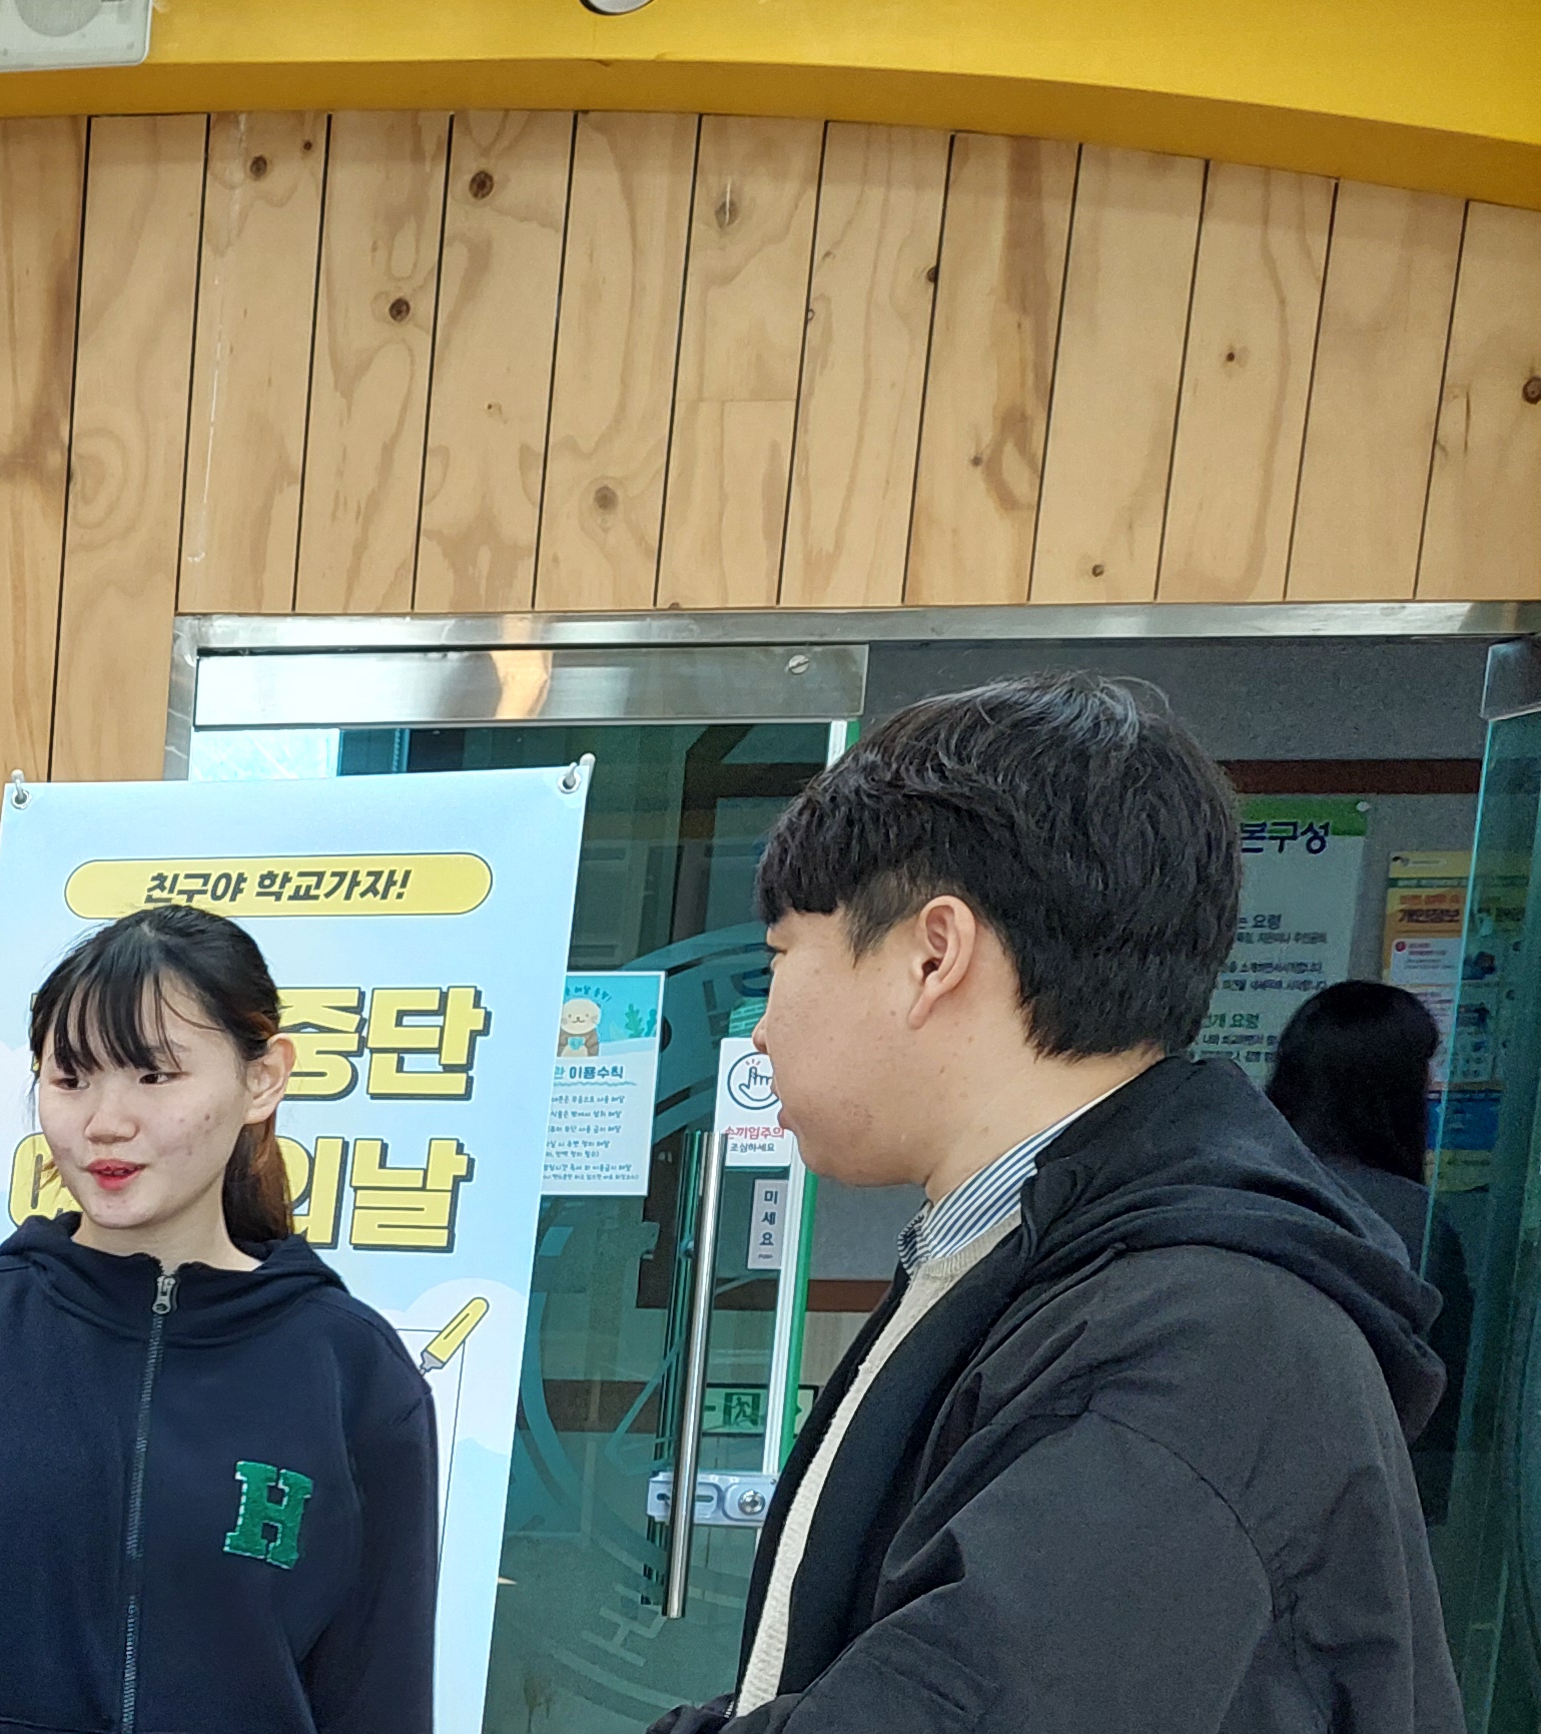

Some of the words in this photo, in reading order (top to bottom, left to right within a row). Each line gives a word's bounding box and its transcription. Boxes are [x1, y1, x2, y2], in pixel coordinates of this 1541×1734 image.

[144, 872, 245, 904] 친구야
[254, 869, 412, 902] 학교가자!
[280, 986, 491, 1101] 중단
[569, 1065, 624, 1080] 이용수칙
[759, 1190, 778, 1246] 미세요
[222, 1459, 315, 1570] H
